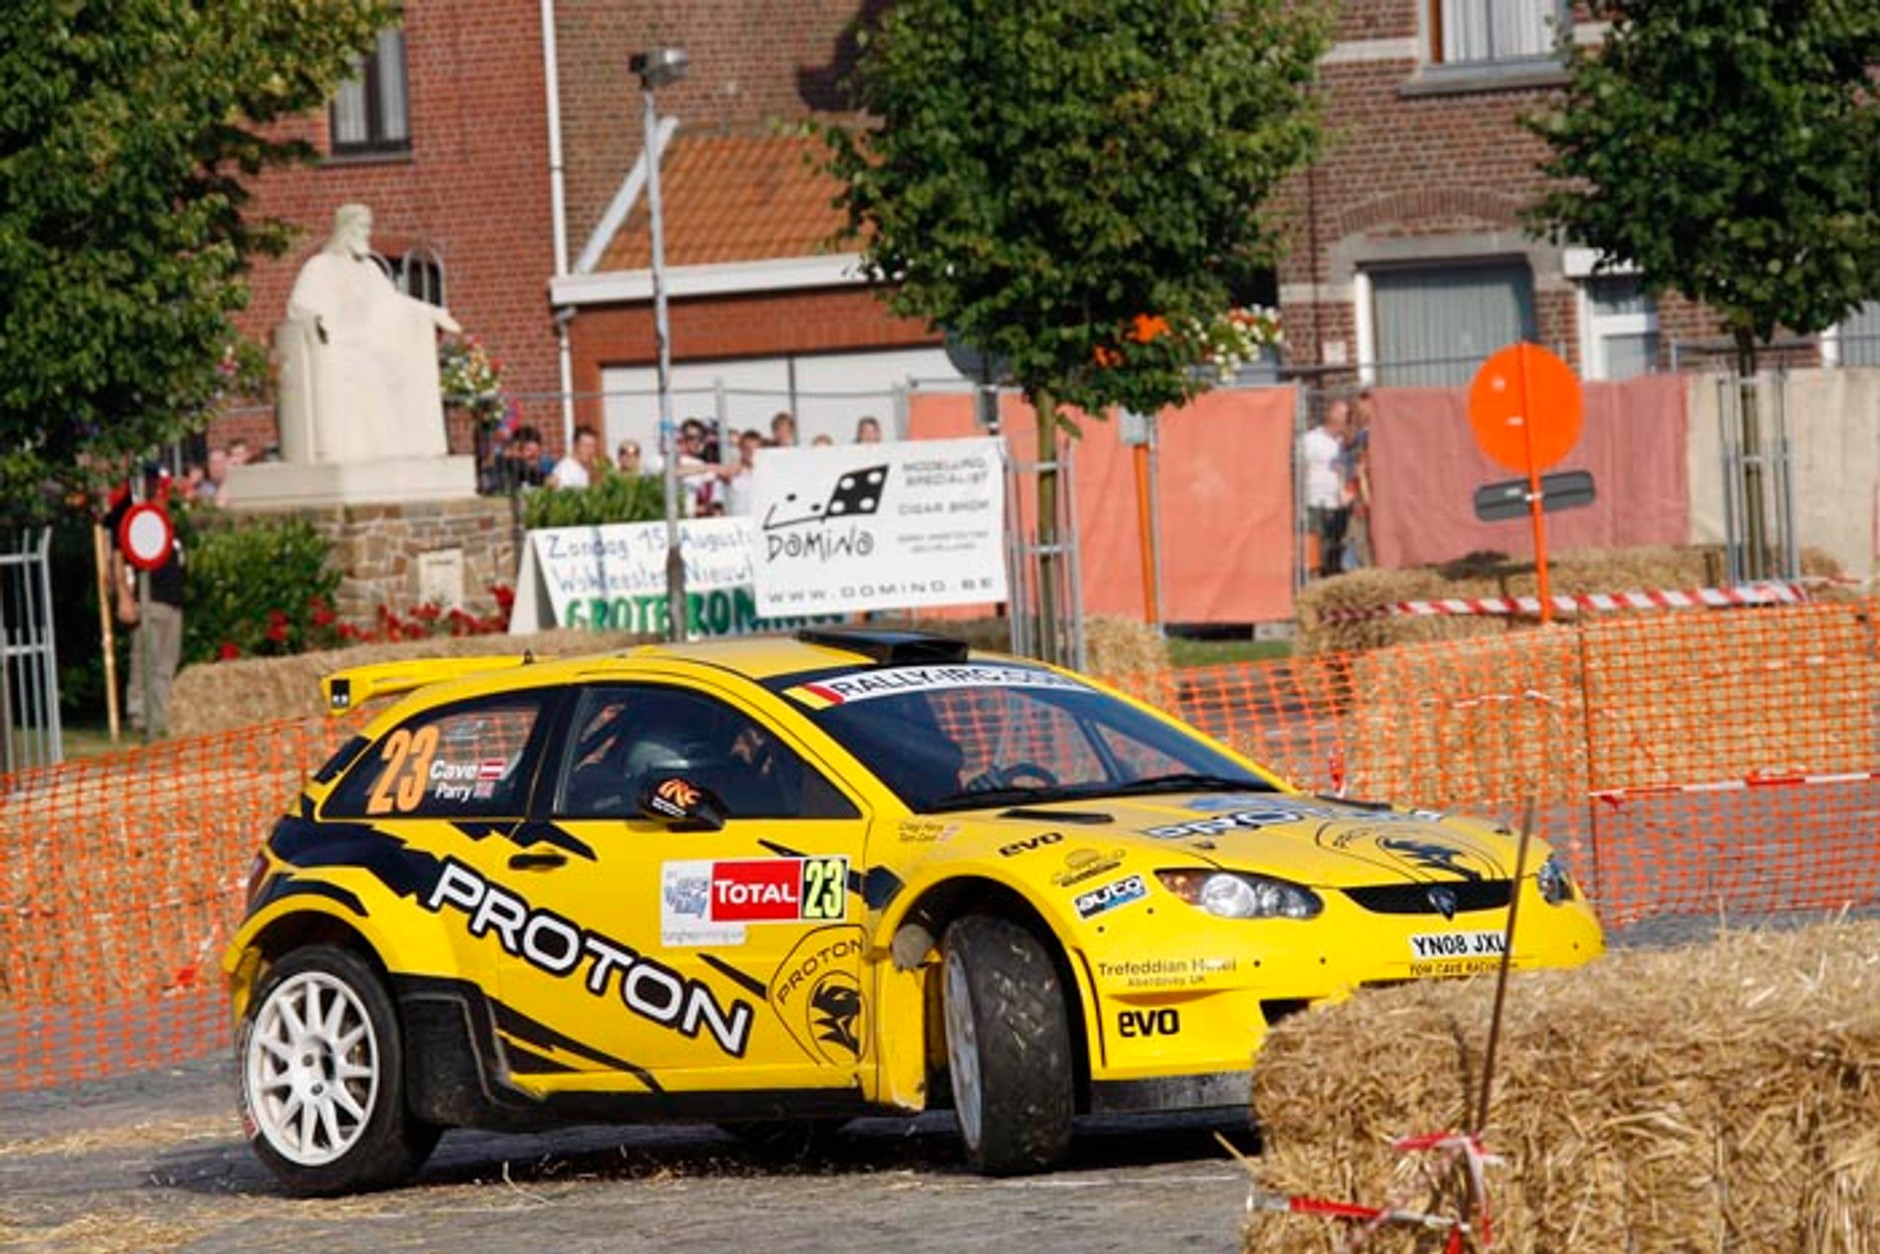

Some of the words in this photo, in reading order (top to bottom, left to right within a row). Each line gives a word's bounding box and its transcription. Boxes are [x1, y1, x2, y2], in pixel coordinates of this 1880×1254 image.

[767, 577, 993, 603] WWW.DOMINO.BE
[365, 724, 440, 815] 23
[429, 758, 479, 781] Cave
[434, 781, 474, 804] Parry
[999, 831, 1065, 858] evo
[714, 879, 798, 905] TOTAL
[802, 859, 846, 918] 23
[422, 858, 754, 1057] PROTON
[1412, 934, 1468, 956] YN08
[775, 937, 864, 1005] PROTON
[1098, 958, 1189, 977] Trefeddian
[1191, 957, 1238, 973] Hel
[1117, 1007, 1181, 1039] evo
